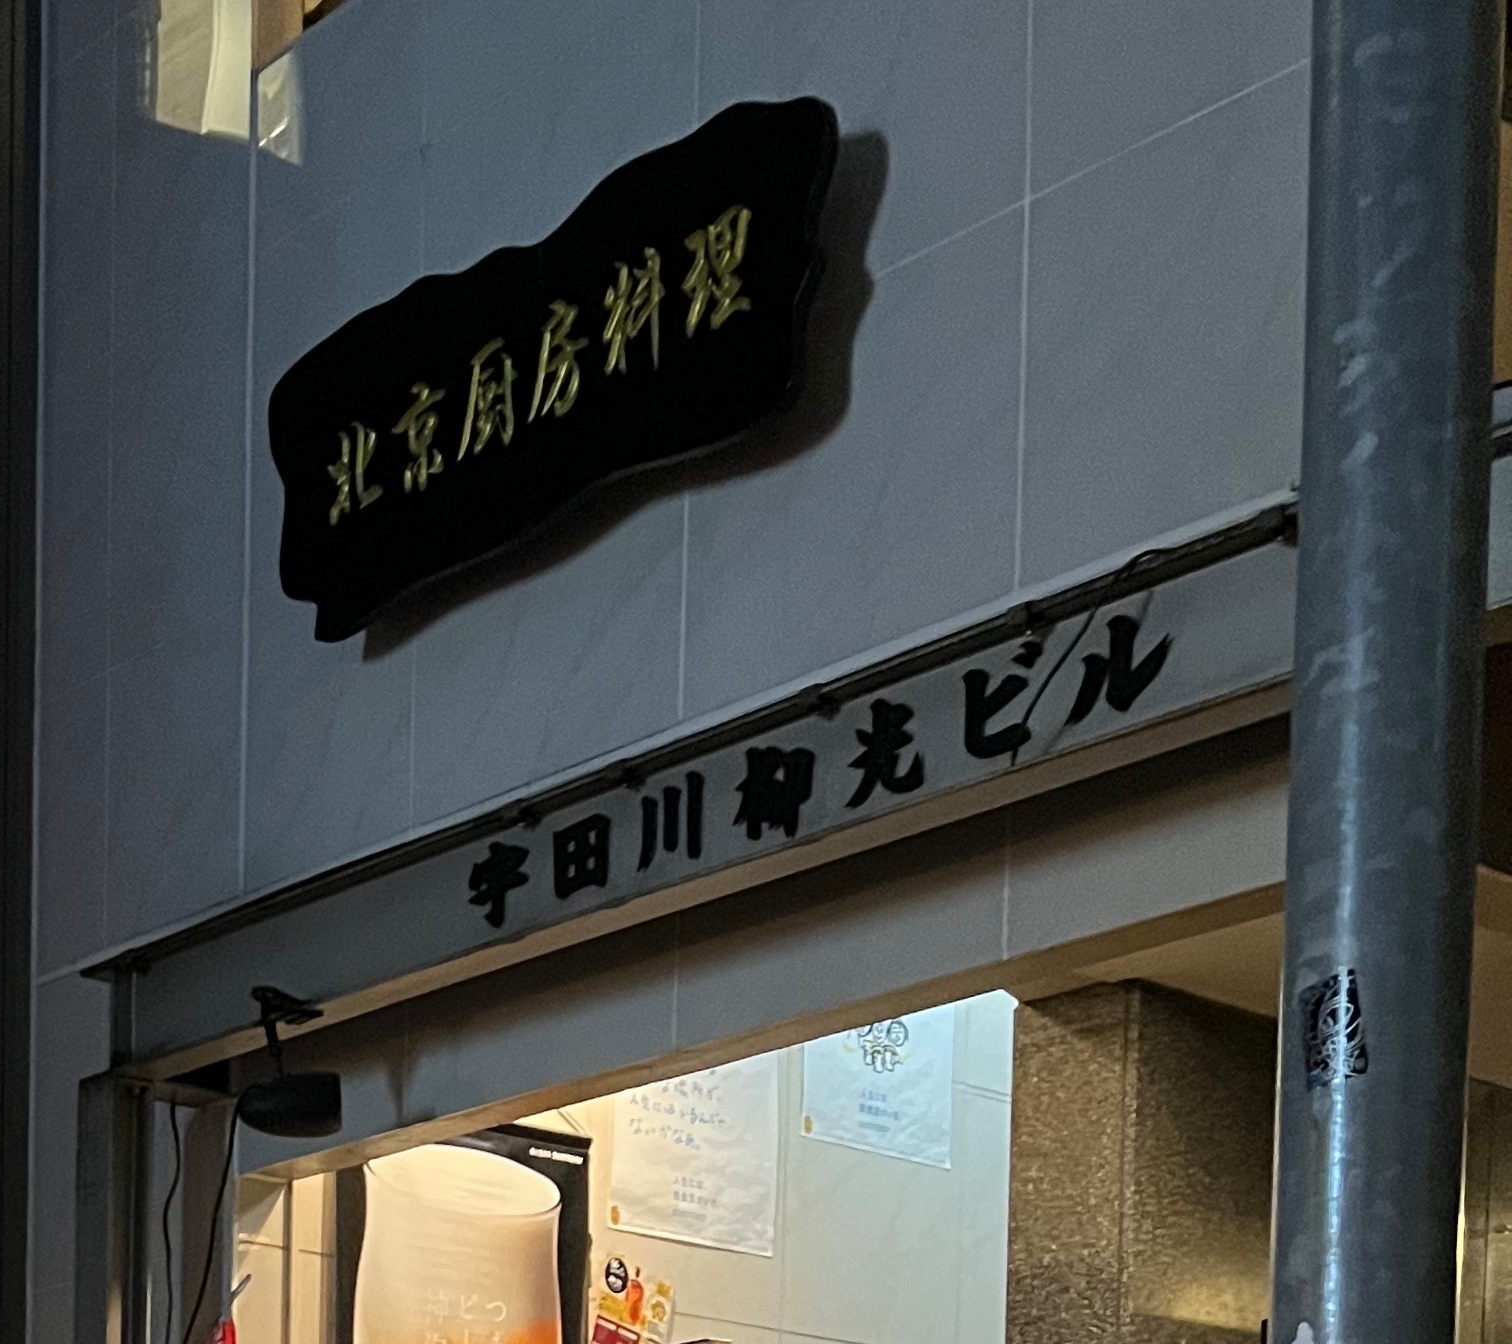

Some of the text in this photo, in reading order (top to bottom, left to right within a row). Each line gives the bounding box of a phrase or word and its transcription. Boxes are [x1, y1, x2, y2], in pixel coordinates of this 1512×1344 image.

[326, 205, 753, 525] 北京厨房料理
[467, 610, 1174, 928] 宇田川柳光ビル
